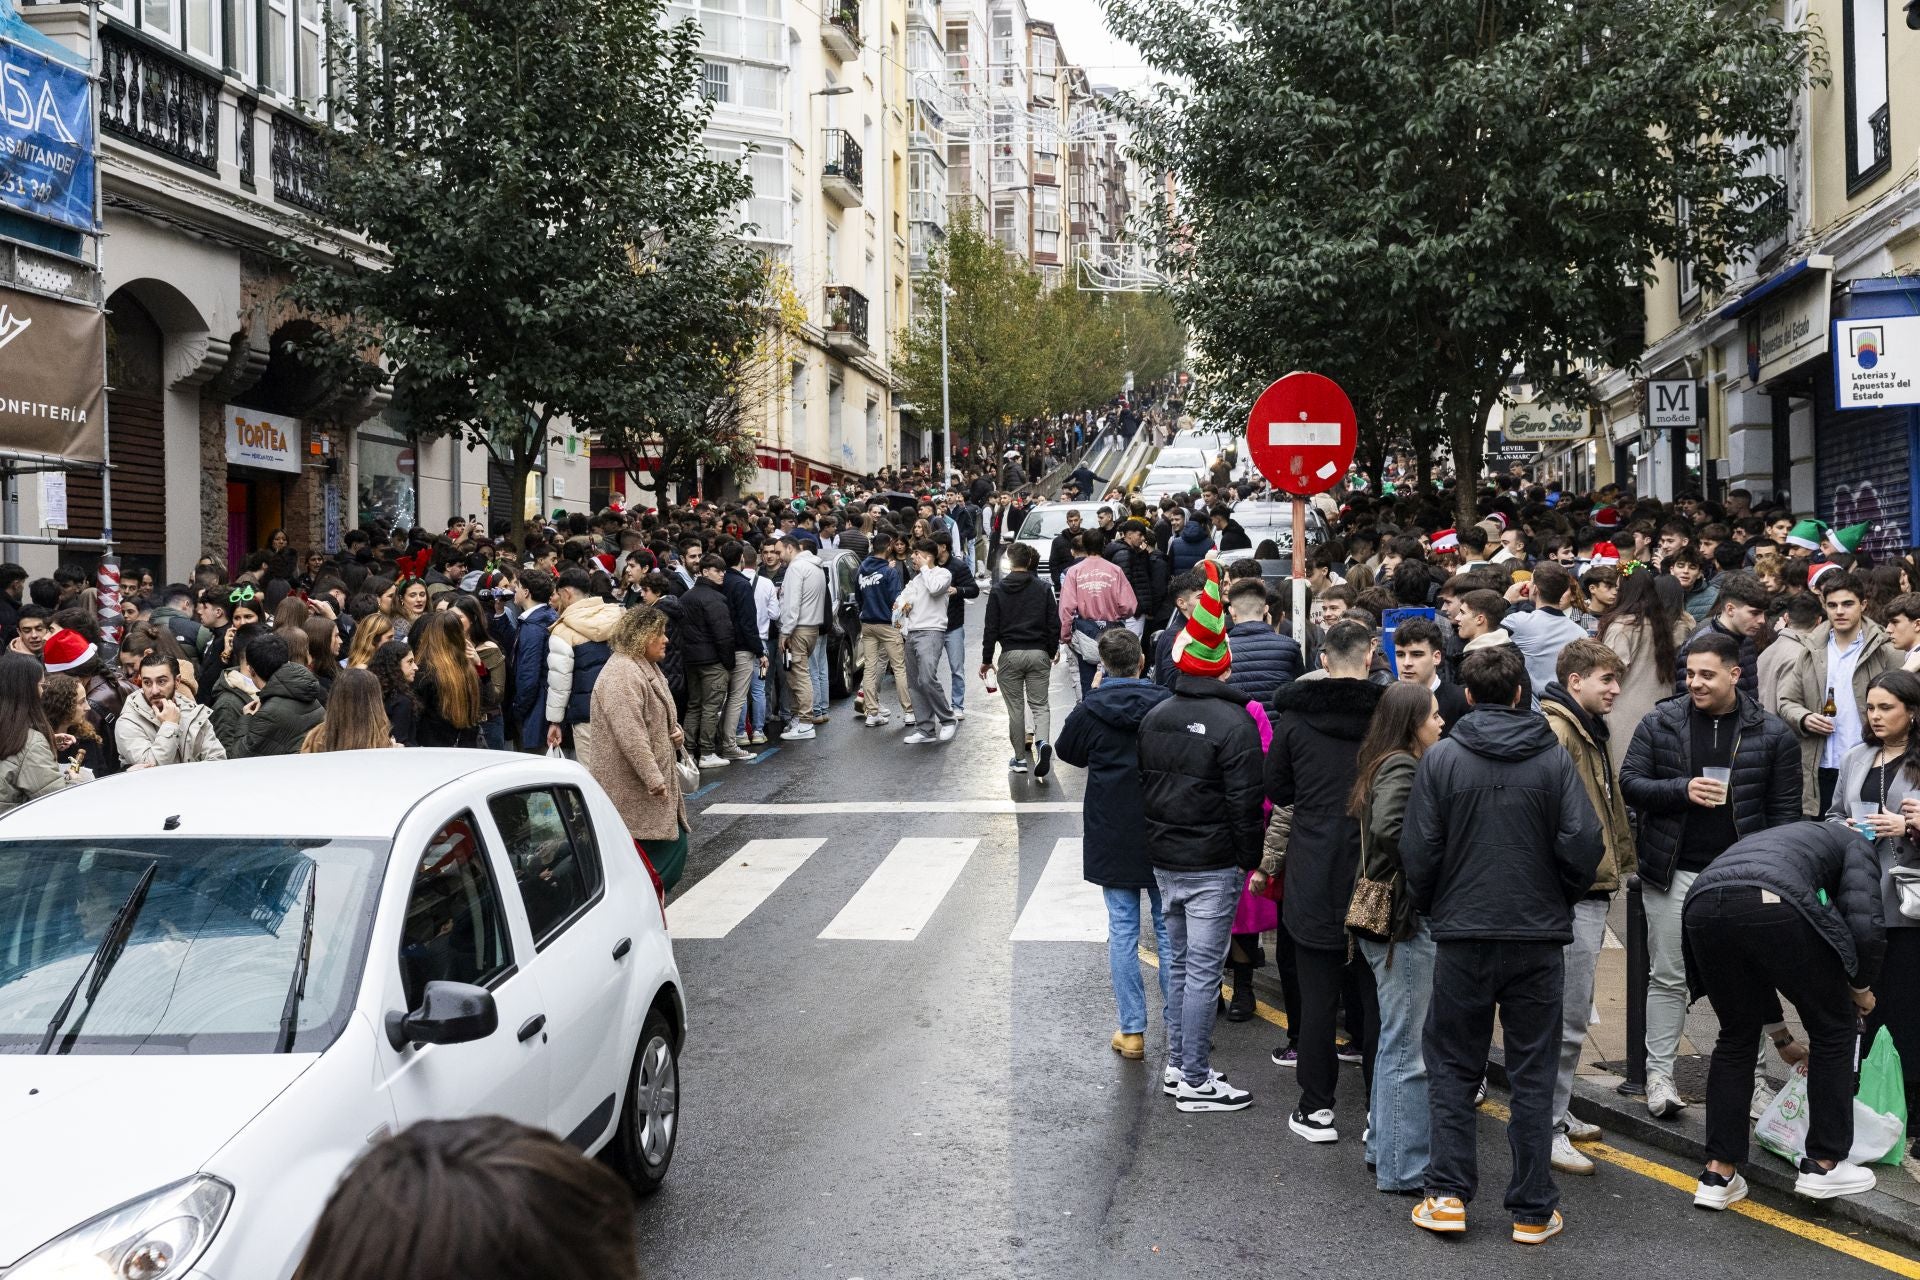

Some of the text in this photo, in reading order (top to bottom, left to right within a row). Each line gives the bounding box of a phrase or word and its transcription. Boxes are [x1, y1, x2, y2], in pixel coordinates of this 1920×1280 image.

[1792, 314, 1809, 341] Estado
[1891, 371, 1896, 380] y
[1852, 379, 1911, 391] Apuestas del
[1656, 384, 1689, 411] M
[1852, 391, 1884, 400] Estado
[1509, 413, 1583, 435] Euro Shop
[1657, 414, 1690, 423] mo&de
